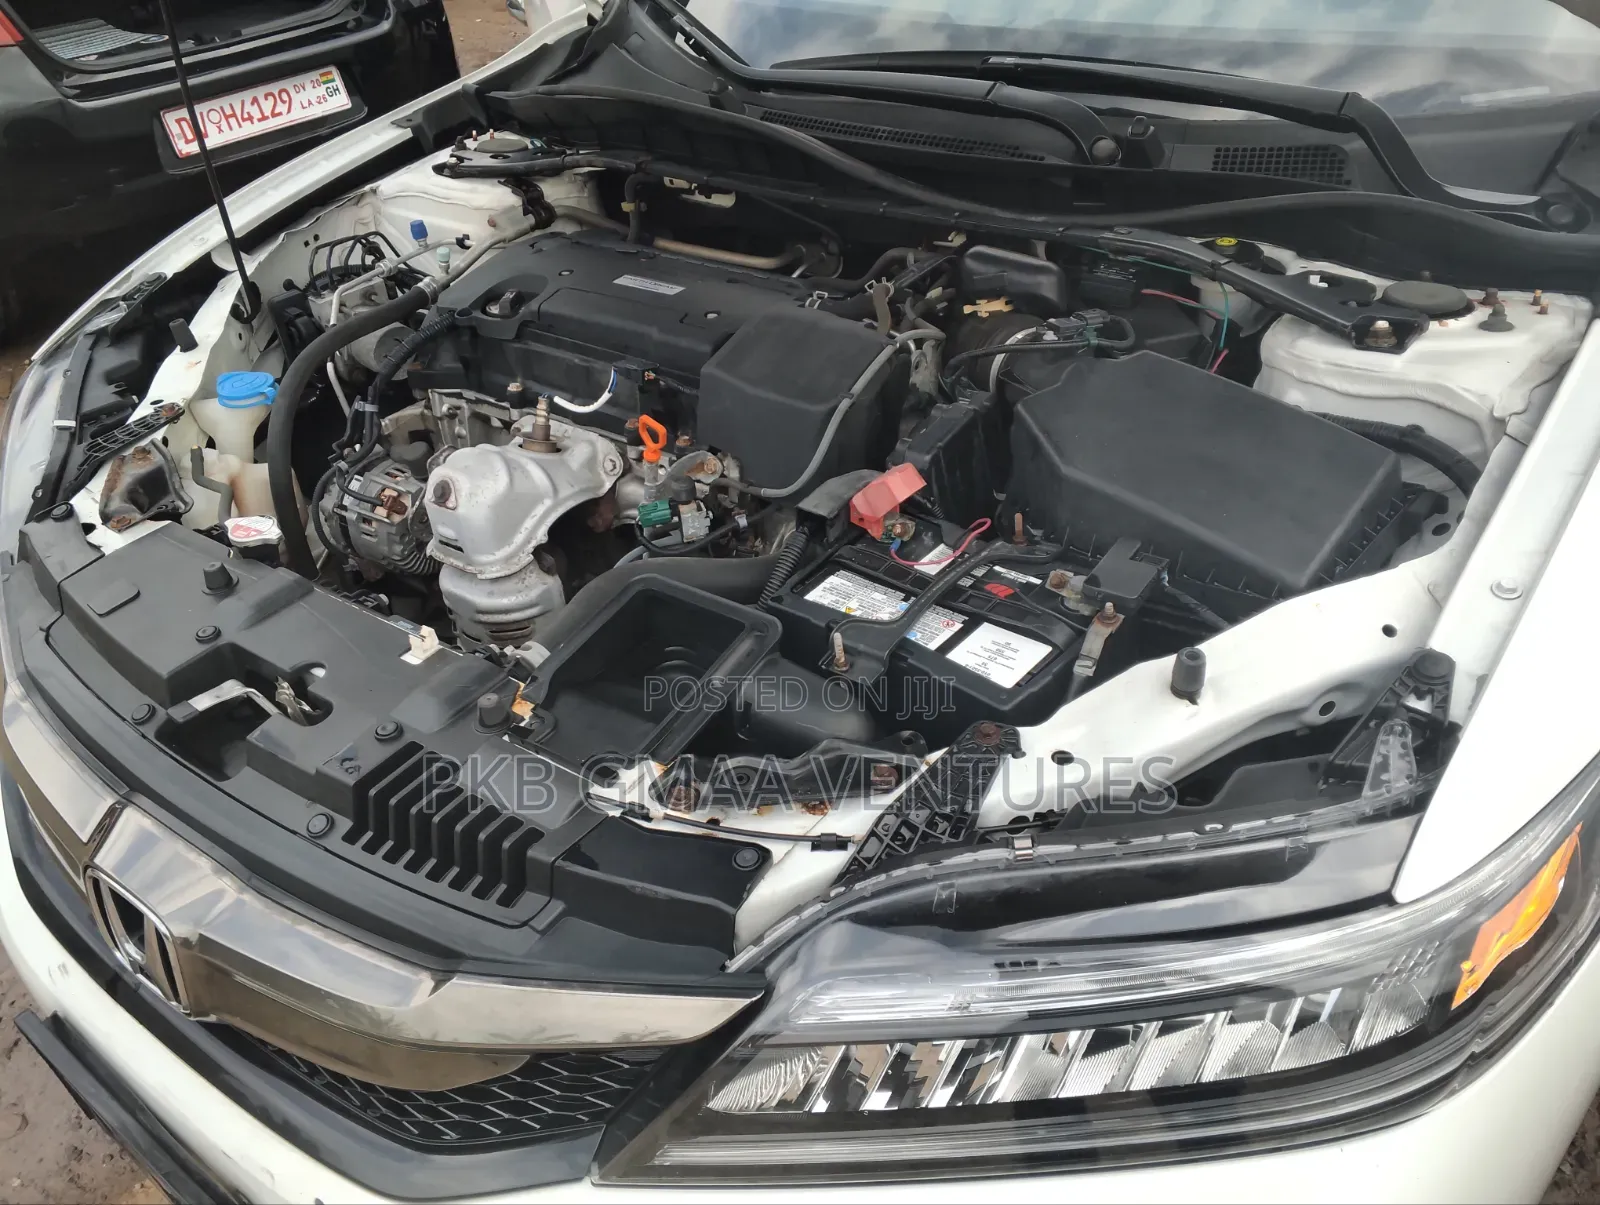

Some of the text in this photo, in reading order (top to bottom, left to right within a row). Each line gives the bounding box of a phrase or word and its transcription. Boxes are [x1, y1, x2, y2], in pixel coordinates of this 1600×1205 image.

[293, 78, 322, 94] DV 20
[325, 84, 341, 98] GH
[219, 87, 293, 132] H4129
[300, 98, 314, 110] LA
